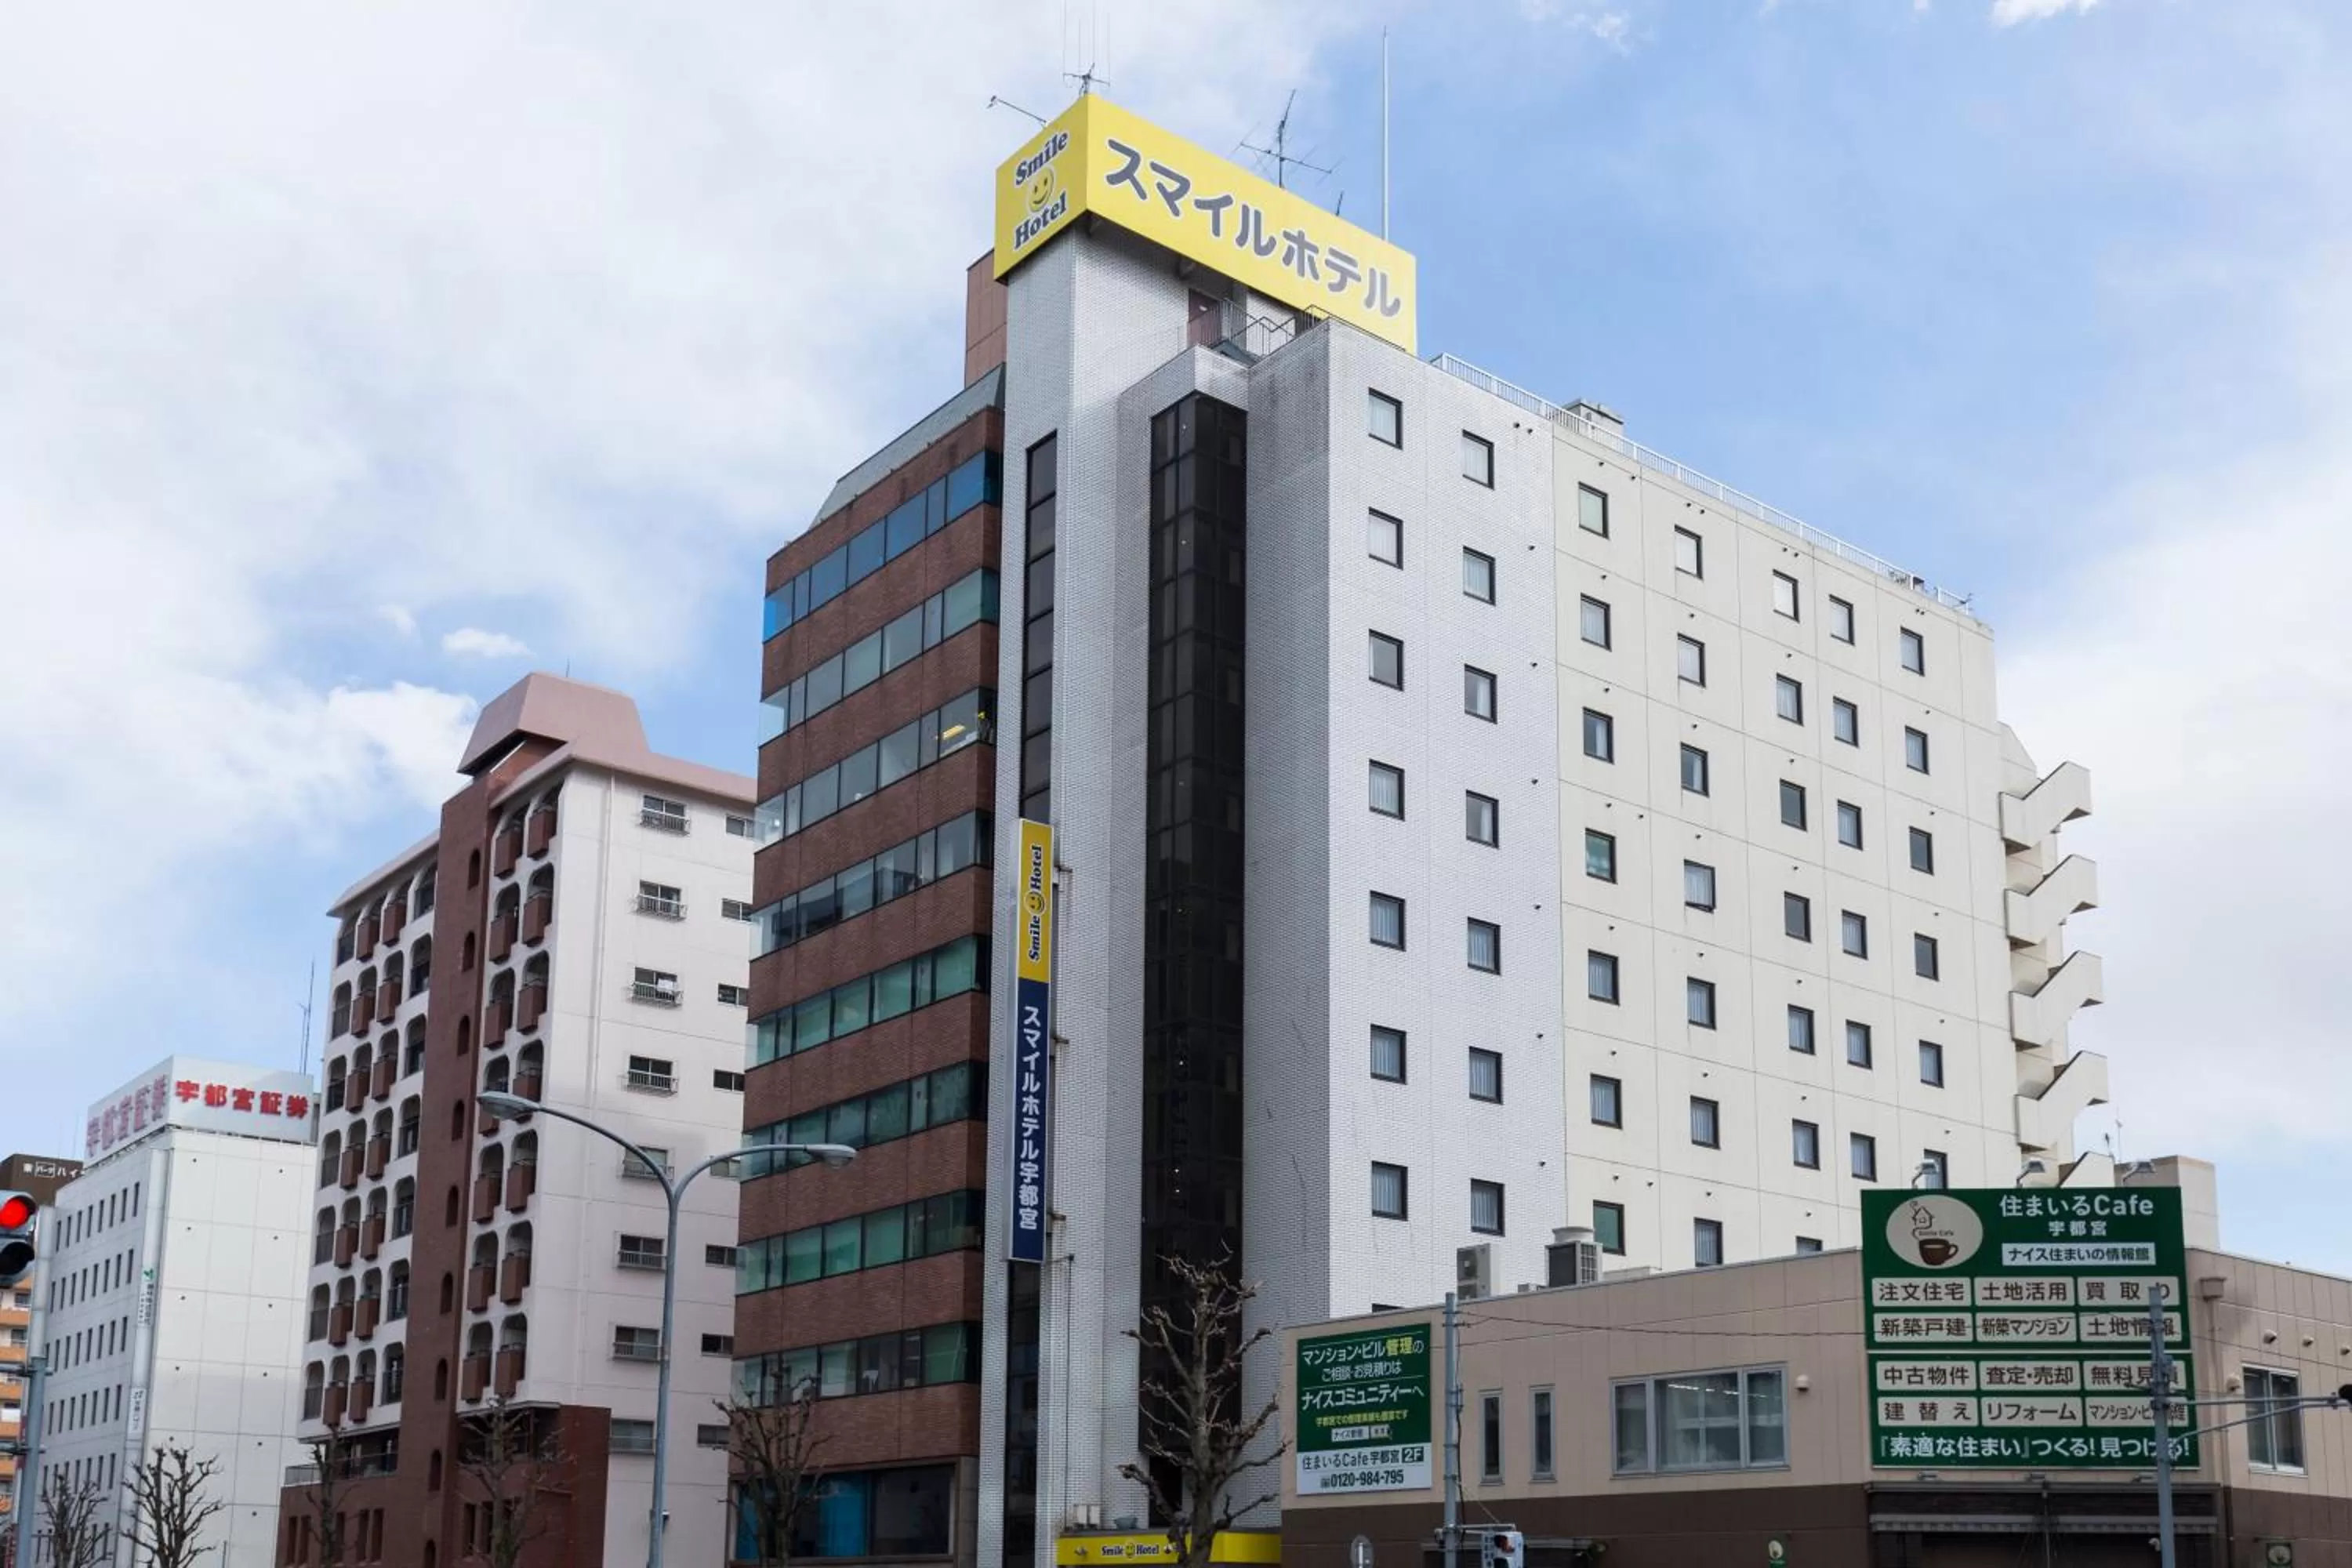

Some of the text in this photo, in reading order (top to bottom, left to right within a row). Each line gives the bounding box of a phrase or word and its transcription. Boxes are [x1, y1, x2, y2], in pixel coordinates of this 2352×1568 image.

[1015, 132, 1068, 186] Smile
[1014, 191, 1067, 249] Hotel
[1105, 139, 1401, 317] スマイルホテル
[1029, 845, 1042, 960] Smile Hotel
[175, 1080, 309, 1120] 宇都宮証券
[1019, 1006, 1041, 1230] スマイルホテル宇都宮
[1999, 1194, 2154, 1217] 住まいるCafe
[2049, 1220, 2107, 1237] 宇都宮
[2008, 1247, 2150, 1262] ナイス住まいの情報館
[1879, 1282, 1965, 1301] 注文住宅
[1981, 1282, 2067, 1301] 土地活用
[1881, 1317, 1966, 1337] 新築戸建
[1981, 1317, 2071, 1336] 新築マンション
[1884, 1367, 1970, 1385] 中古物件
[1986, 1367, 2074, 1385] 査定・売却
[1301, 1384, 1425, 1410] ナイスコミュニティーへ
[1884, 1402, 1971, 1421] 建替え
[1987, 1403, 2077, 1421] リフォーム
[1302, 1447, 1424, 1470] 住まいるCafe宇都宮 2F
[1330, 1469, 1404, 1487] 0120-984-795
